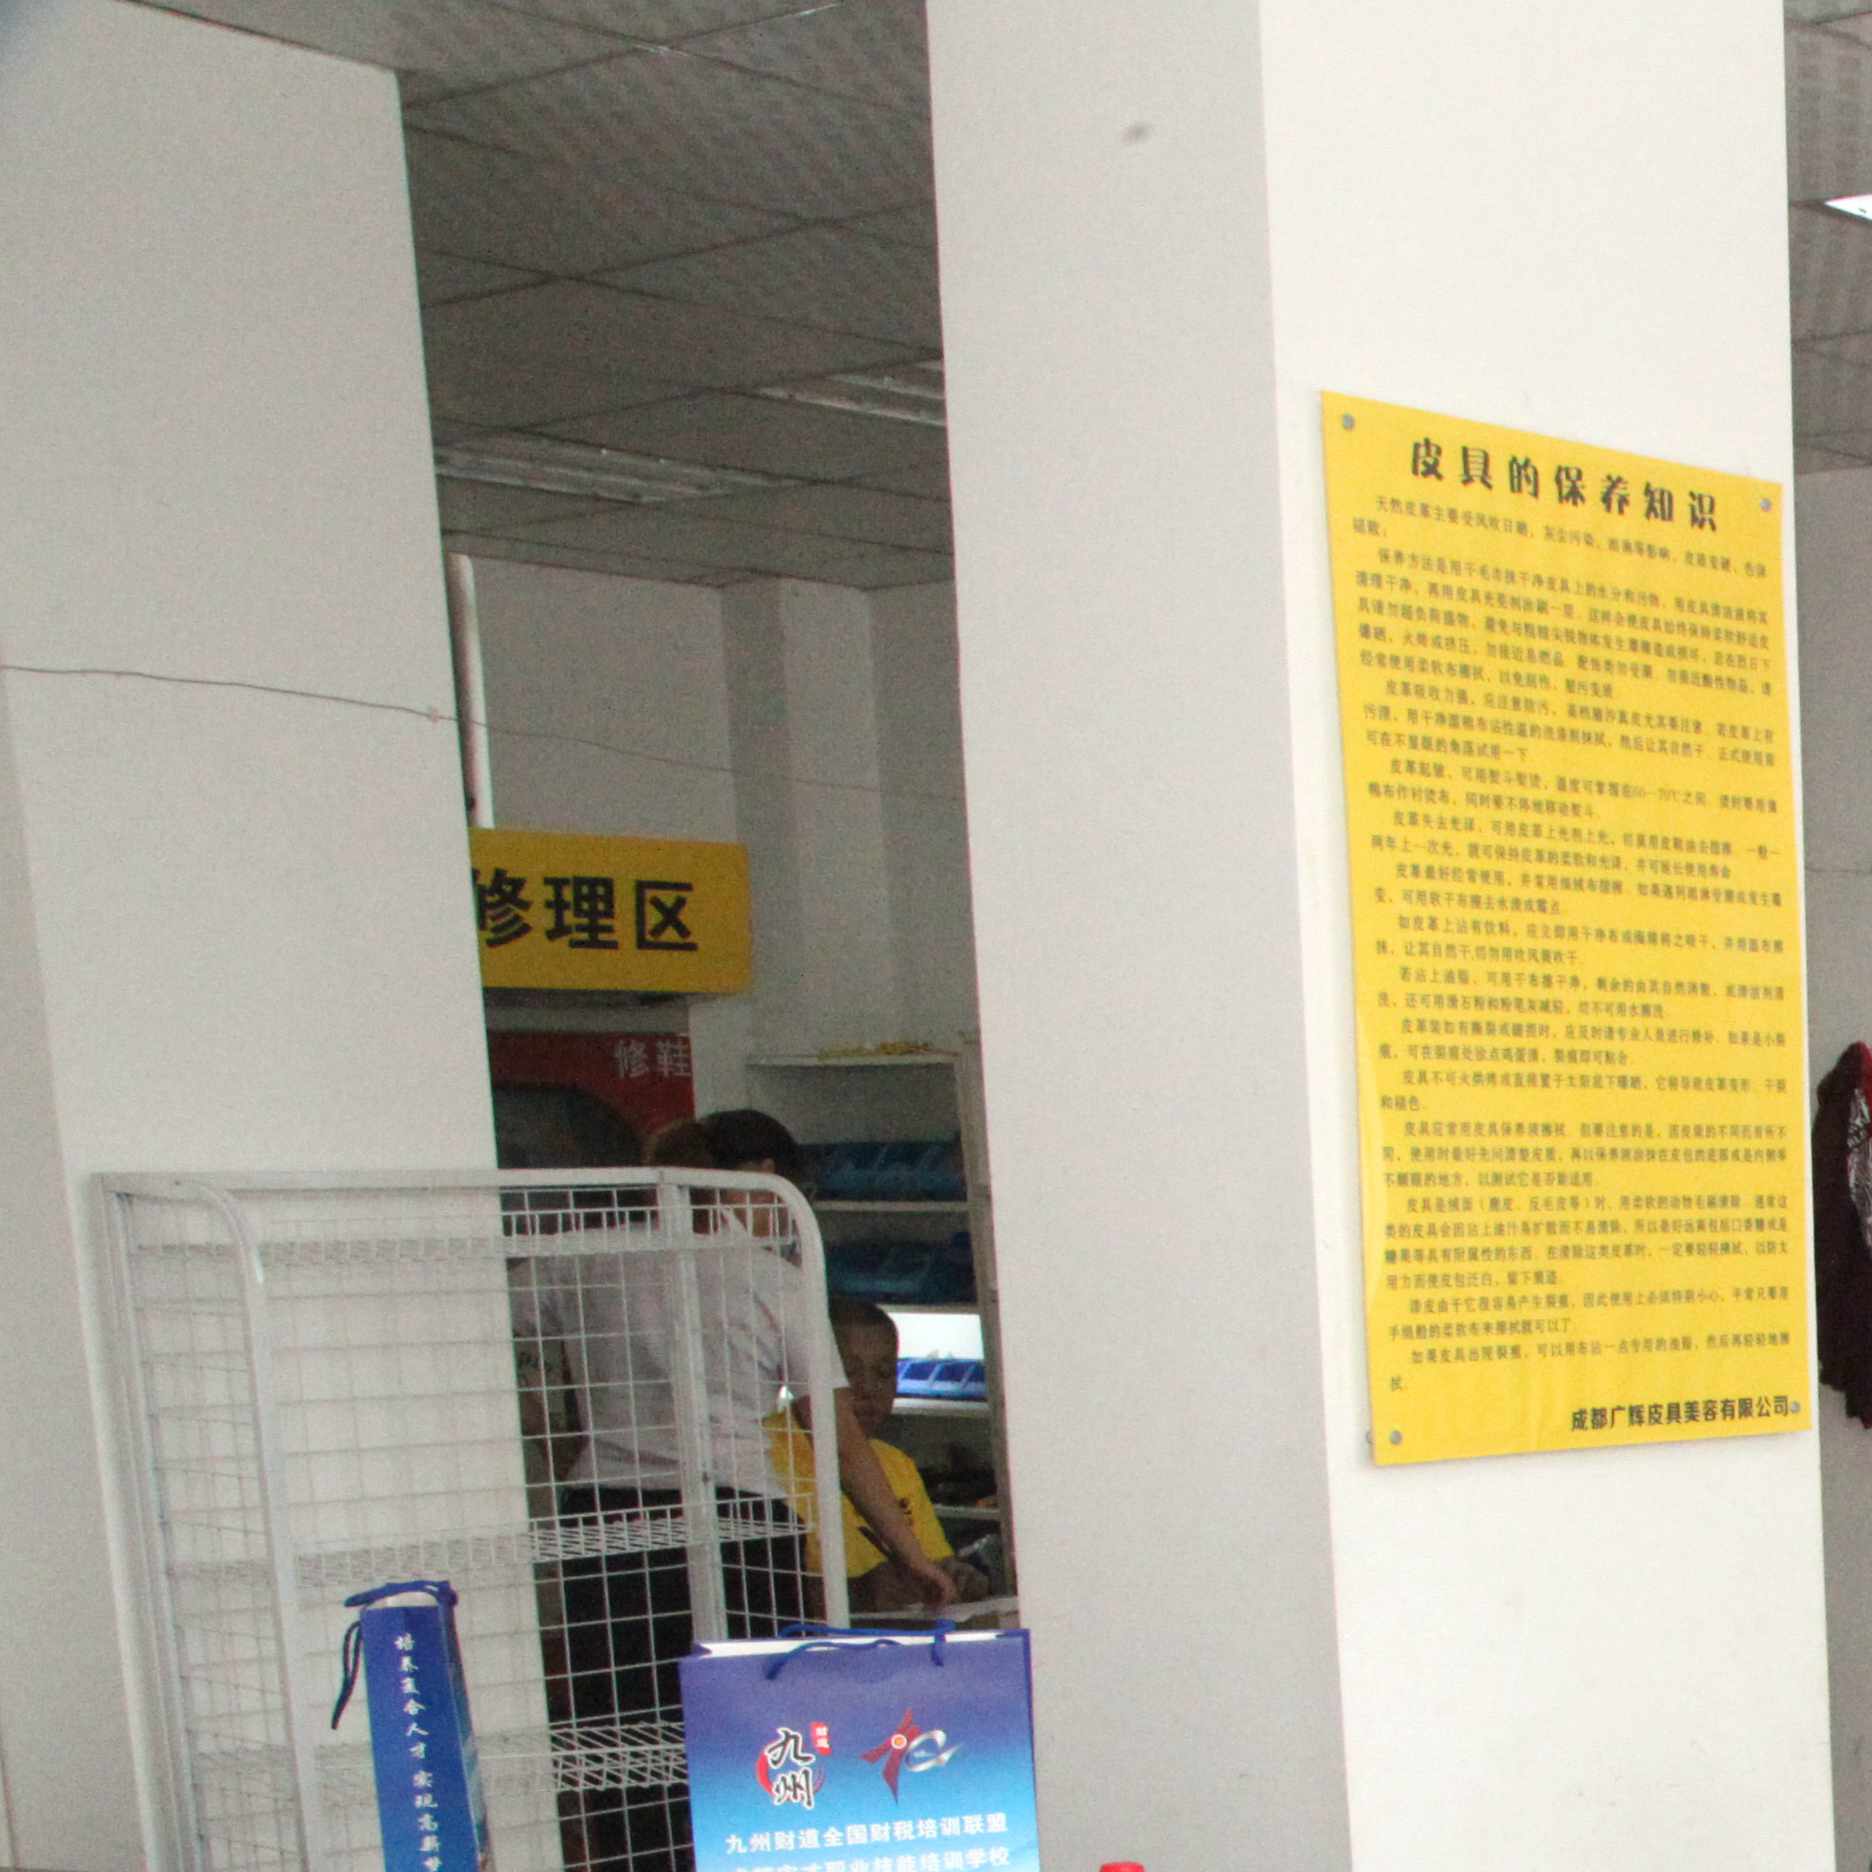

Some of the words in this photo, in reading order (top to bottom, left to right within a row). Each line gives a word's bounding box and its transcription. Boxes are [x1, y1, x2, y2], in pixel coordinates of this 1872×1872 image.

[473, 866, 698, 951] 修理区
[612, 1038, 692, 1079] 修鞋
[1571, 1396, 1790, 1431] 成都广辉皮具美容有限公司
[766, 1729, 814, 1807] 九州
